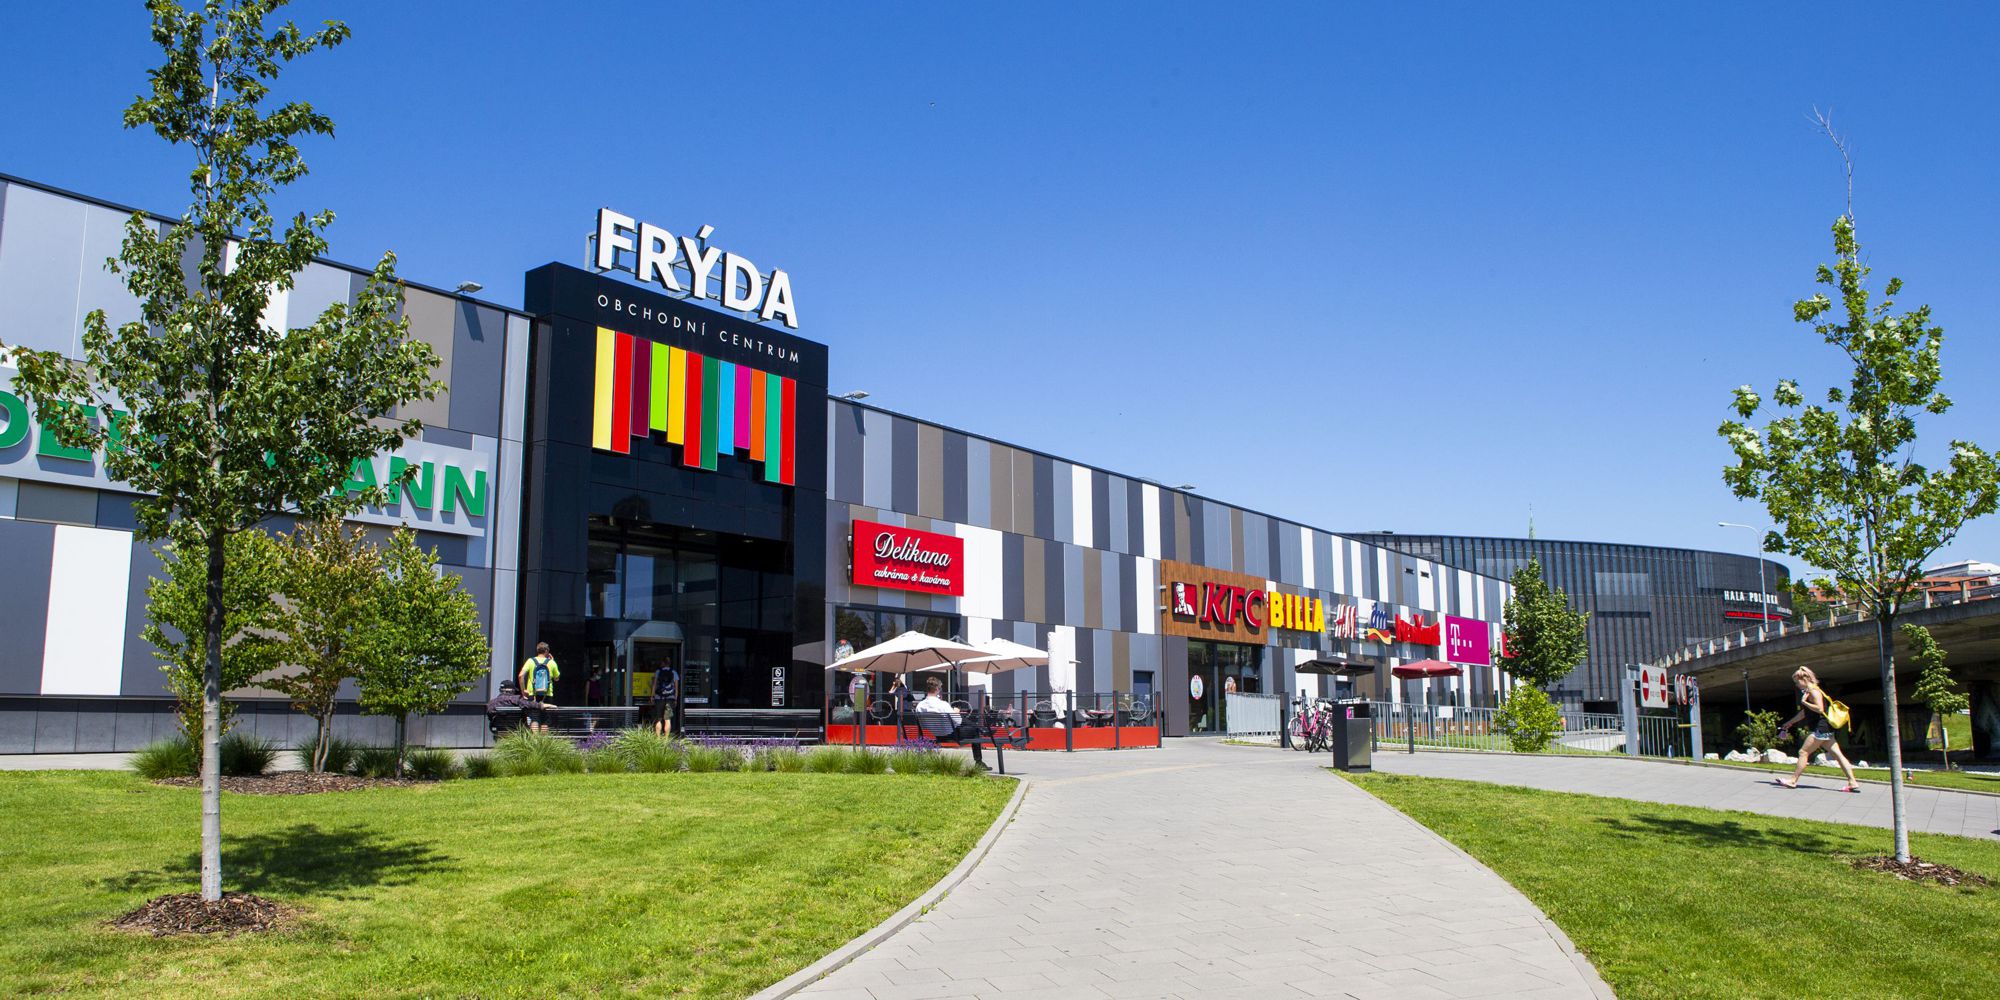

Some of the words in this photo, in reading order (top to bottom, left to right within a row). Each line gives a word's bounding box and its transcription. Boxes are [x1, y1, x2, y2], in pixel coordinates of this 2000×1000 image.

[596, 208, 799, 329] FRÝDA
[597, 294, 706, 336] OBCHODNÍ
[719, 330, 800, 364] CENTRUM
[0, 391, 486, 517] EIANN
[875, 532, 952, 567] Delikana
[874, 566, 910, 582] cukrárna
[911, 574, 919, 582] &
[919, 571, 951, 586] kavárna
[1201, 582, 1264, 628] KFC
[1268, 591, 1326, 633] BILLA
[1371, 602, 1388, 630] dm
[1724, 590, 1745, 601] HALA
[1749, 592, 1779, 605] POLRKA
